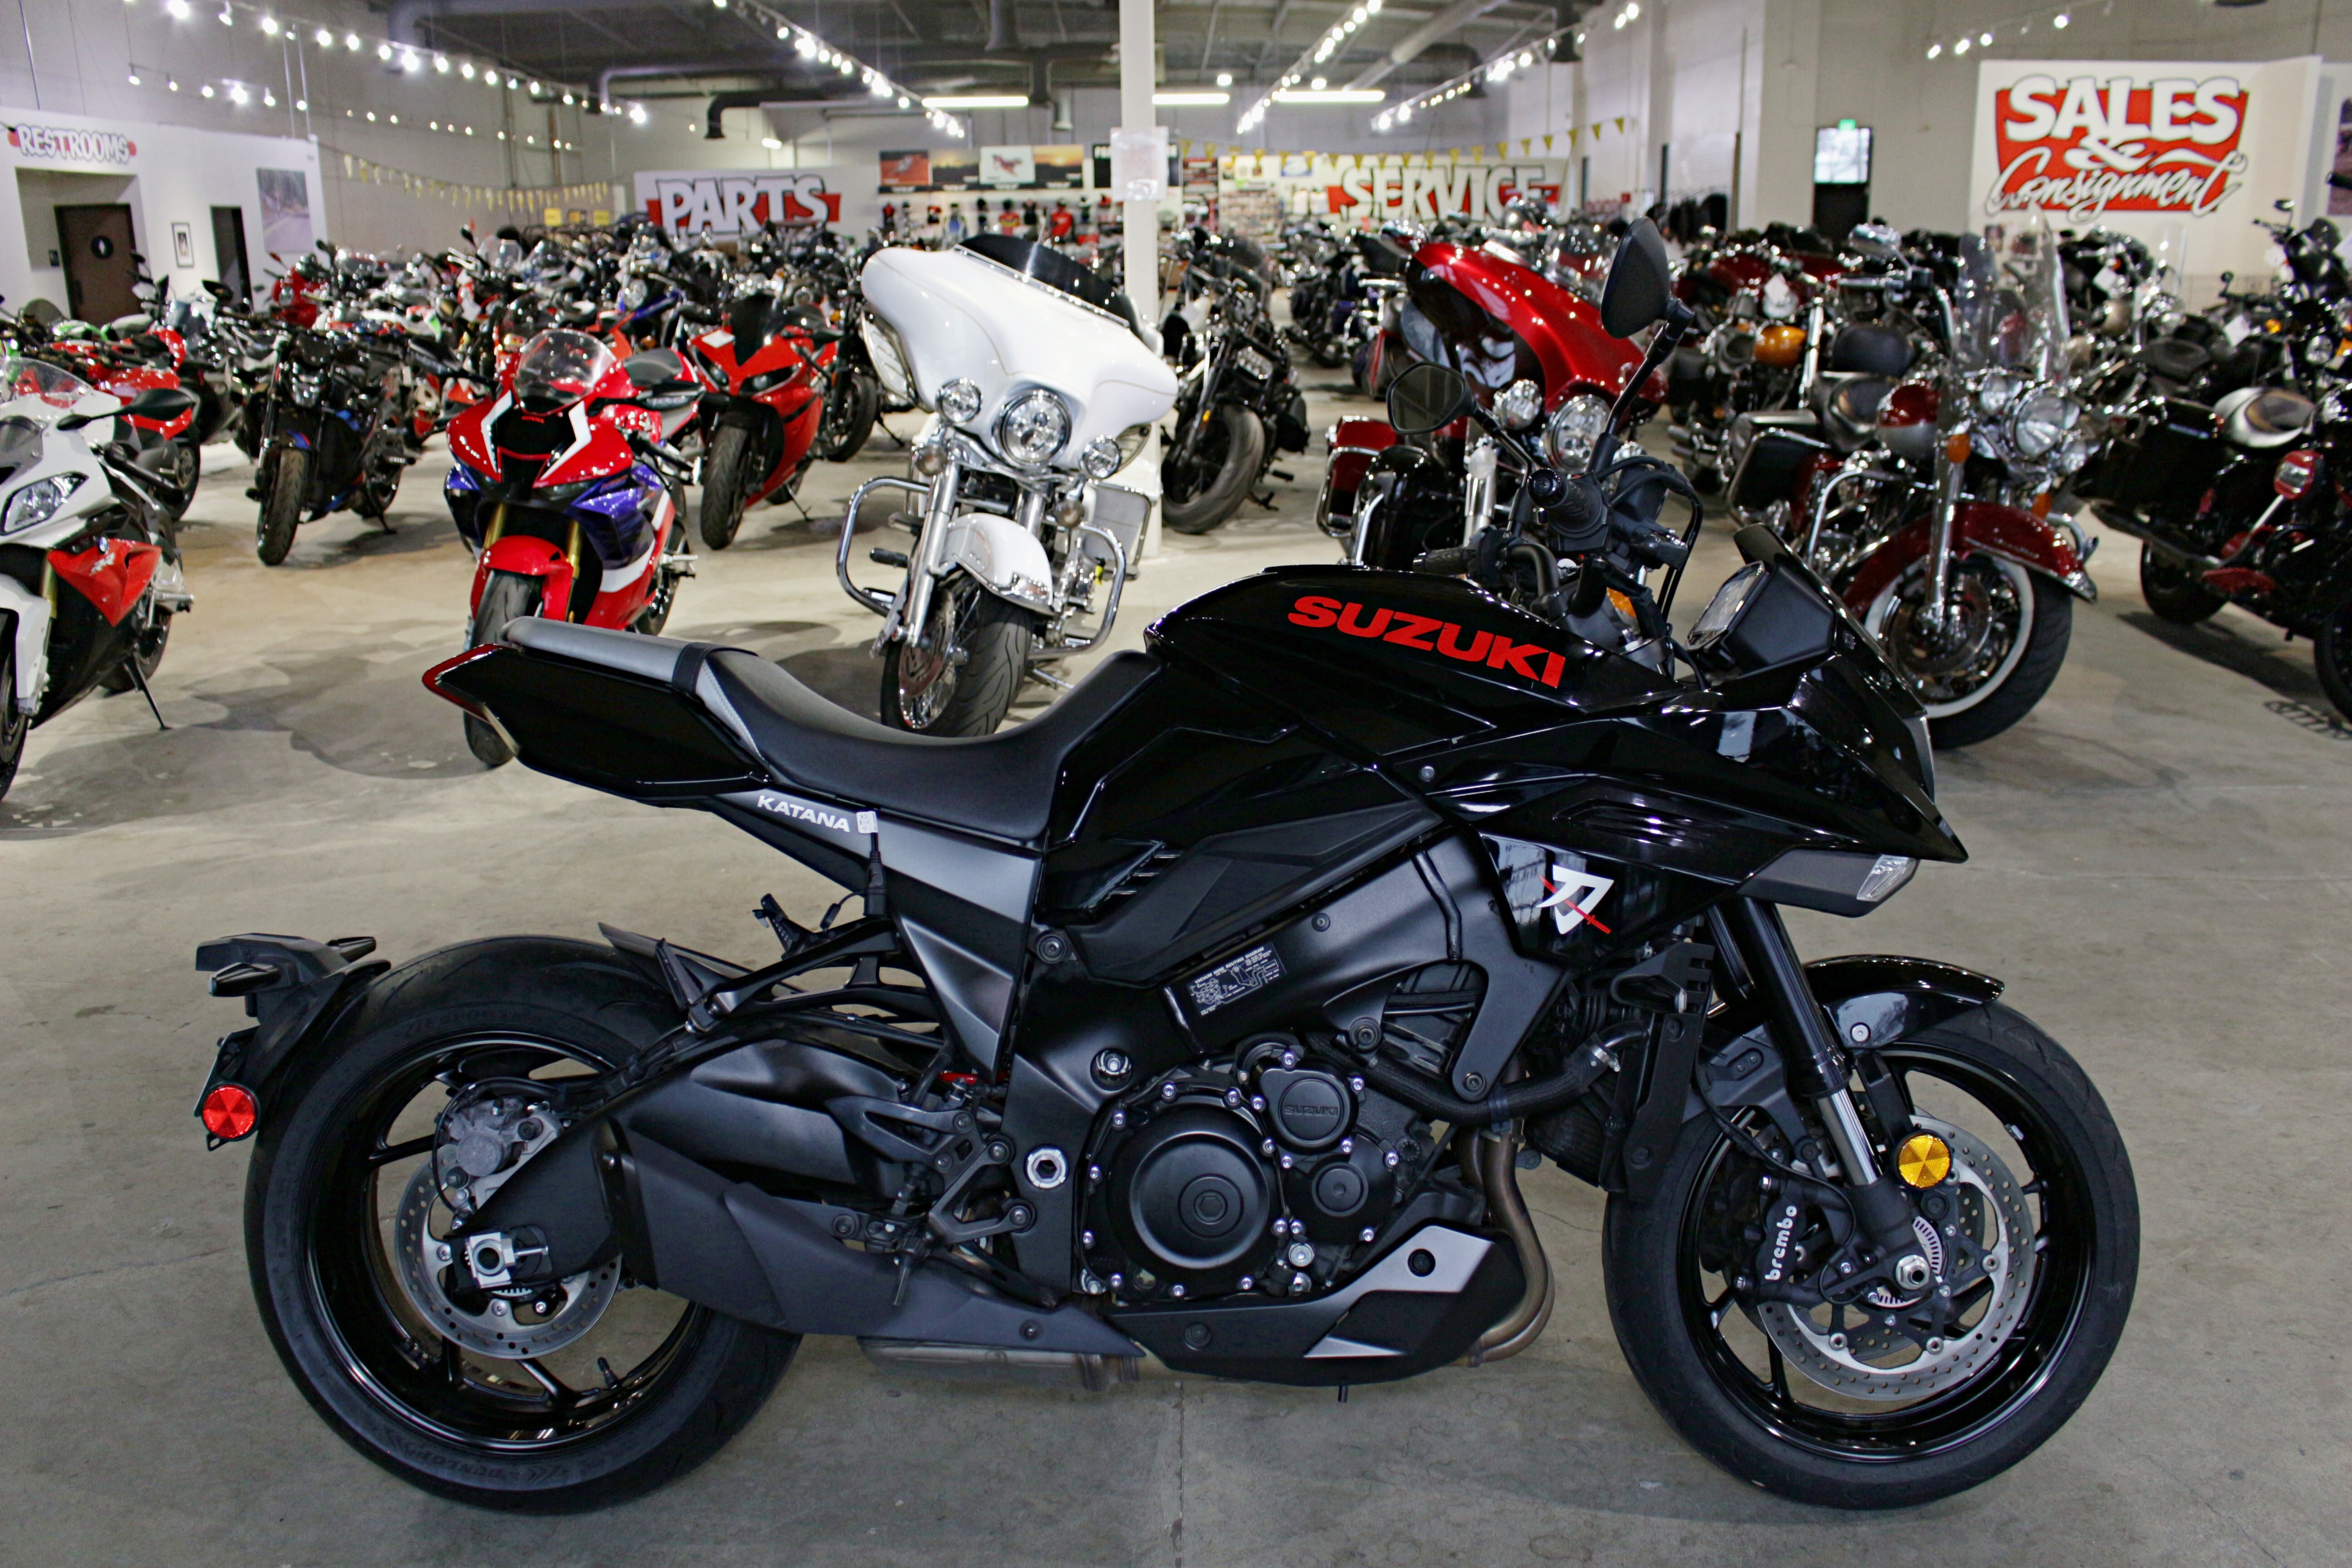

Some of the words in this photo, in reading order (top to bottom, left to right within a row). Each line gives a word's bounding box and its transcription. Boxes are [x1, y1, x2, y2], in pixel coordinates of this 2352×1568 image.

[2005, 74, 2240, 145] SALES
[16, 124, 130, 164] RESTROOMS
[656, 174, 829, 237] PARTS
[1340, 164, 1545, 221] SERVICE
[1984, 146, 2248, 224] Consignment
[1288, 596, 1566, 689] SUZUKI
[757, 795, 850, 833] KATANA
[1195, 973, 1213, 984] VACUUM
[1213, 966, 1225, 975] HOSE
[1226, 957, 1245, 969] ROUTING
[1245, 946, 1264, 959] DIAGRAM
[1284, 1105, 1338, 1116] SUZUKI
[1764, 1205, 1797, 1280] brembo
